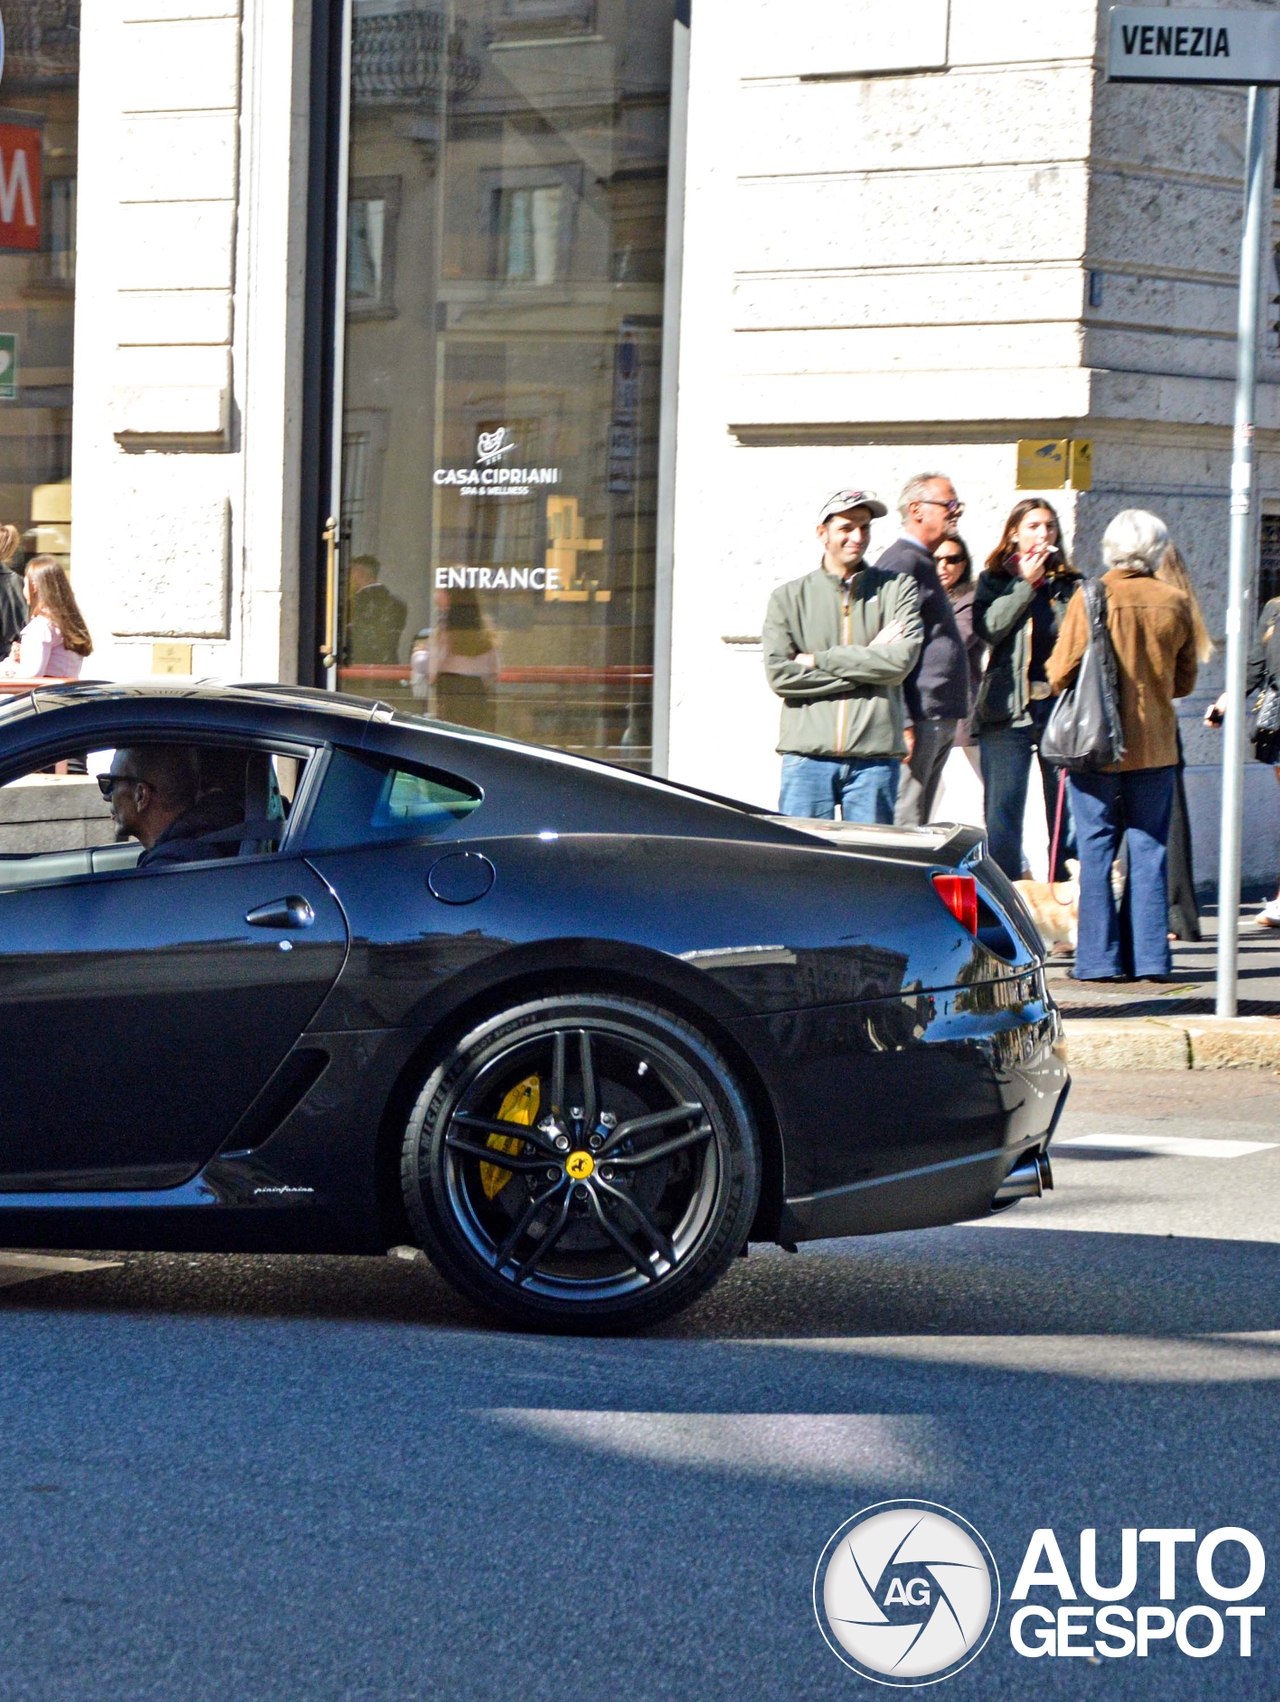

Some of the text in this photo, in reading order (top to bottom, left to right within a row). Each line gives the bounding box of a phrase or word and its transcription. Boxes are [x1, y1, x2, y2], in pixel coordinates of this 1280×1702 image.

[1122, 25, 1230, 57] VENEZIA
[433, 468, 558, 485] CASA CIPRIANI
[460, 487, 477, 495] SPA
[487, 486, 529, 495] WELLNESS
[435, 567, 559, 589] ENTRANCE
